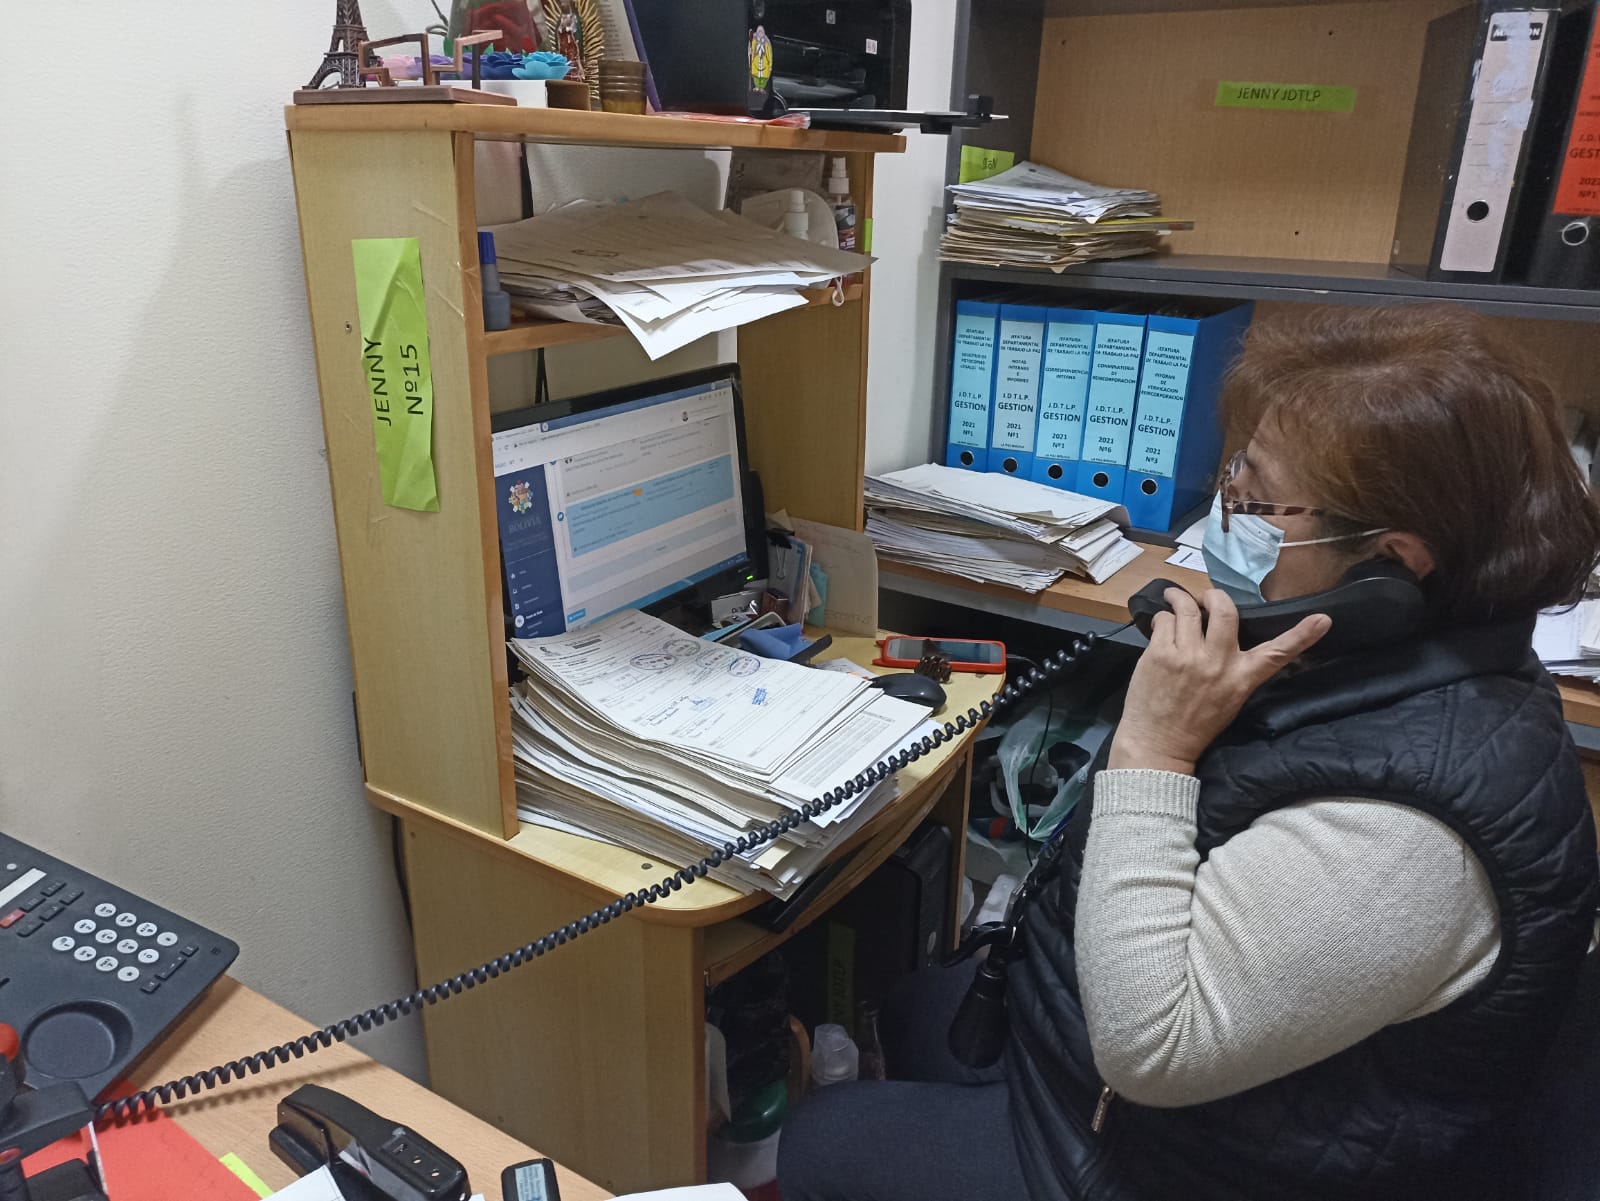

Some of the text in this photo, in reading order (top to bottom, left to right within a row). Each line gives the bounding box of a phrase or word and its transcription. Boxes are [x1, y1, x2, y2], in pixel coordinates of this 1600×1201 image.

[1237, 87, 1321, 102] JENNY JDTLP
[364, 336, 392, 426] JENNY
[399, 343, 424, 415] Nº15
[954, 400, 987, 412] GESTION
[997, 401, 1034, 413] GESTION
[1042, 411, 1081, 423] GESTION
[1089, 414, 1129, 426] GESTION
[962, 420, 976, 428] 2021
[1006, 422, 1022, 430] 2021
[1137, 423, 1176, 438] GESTION
[1098, 436, 1114, 444] 2021
[1145, 446, 1161, 455] 2021
